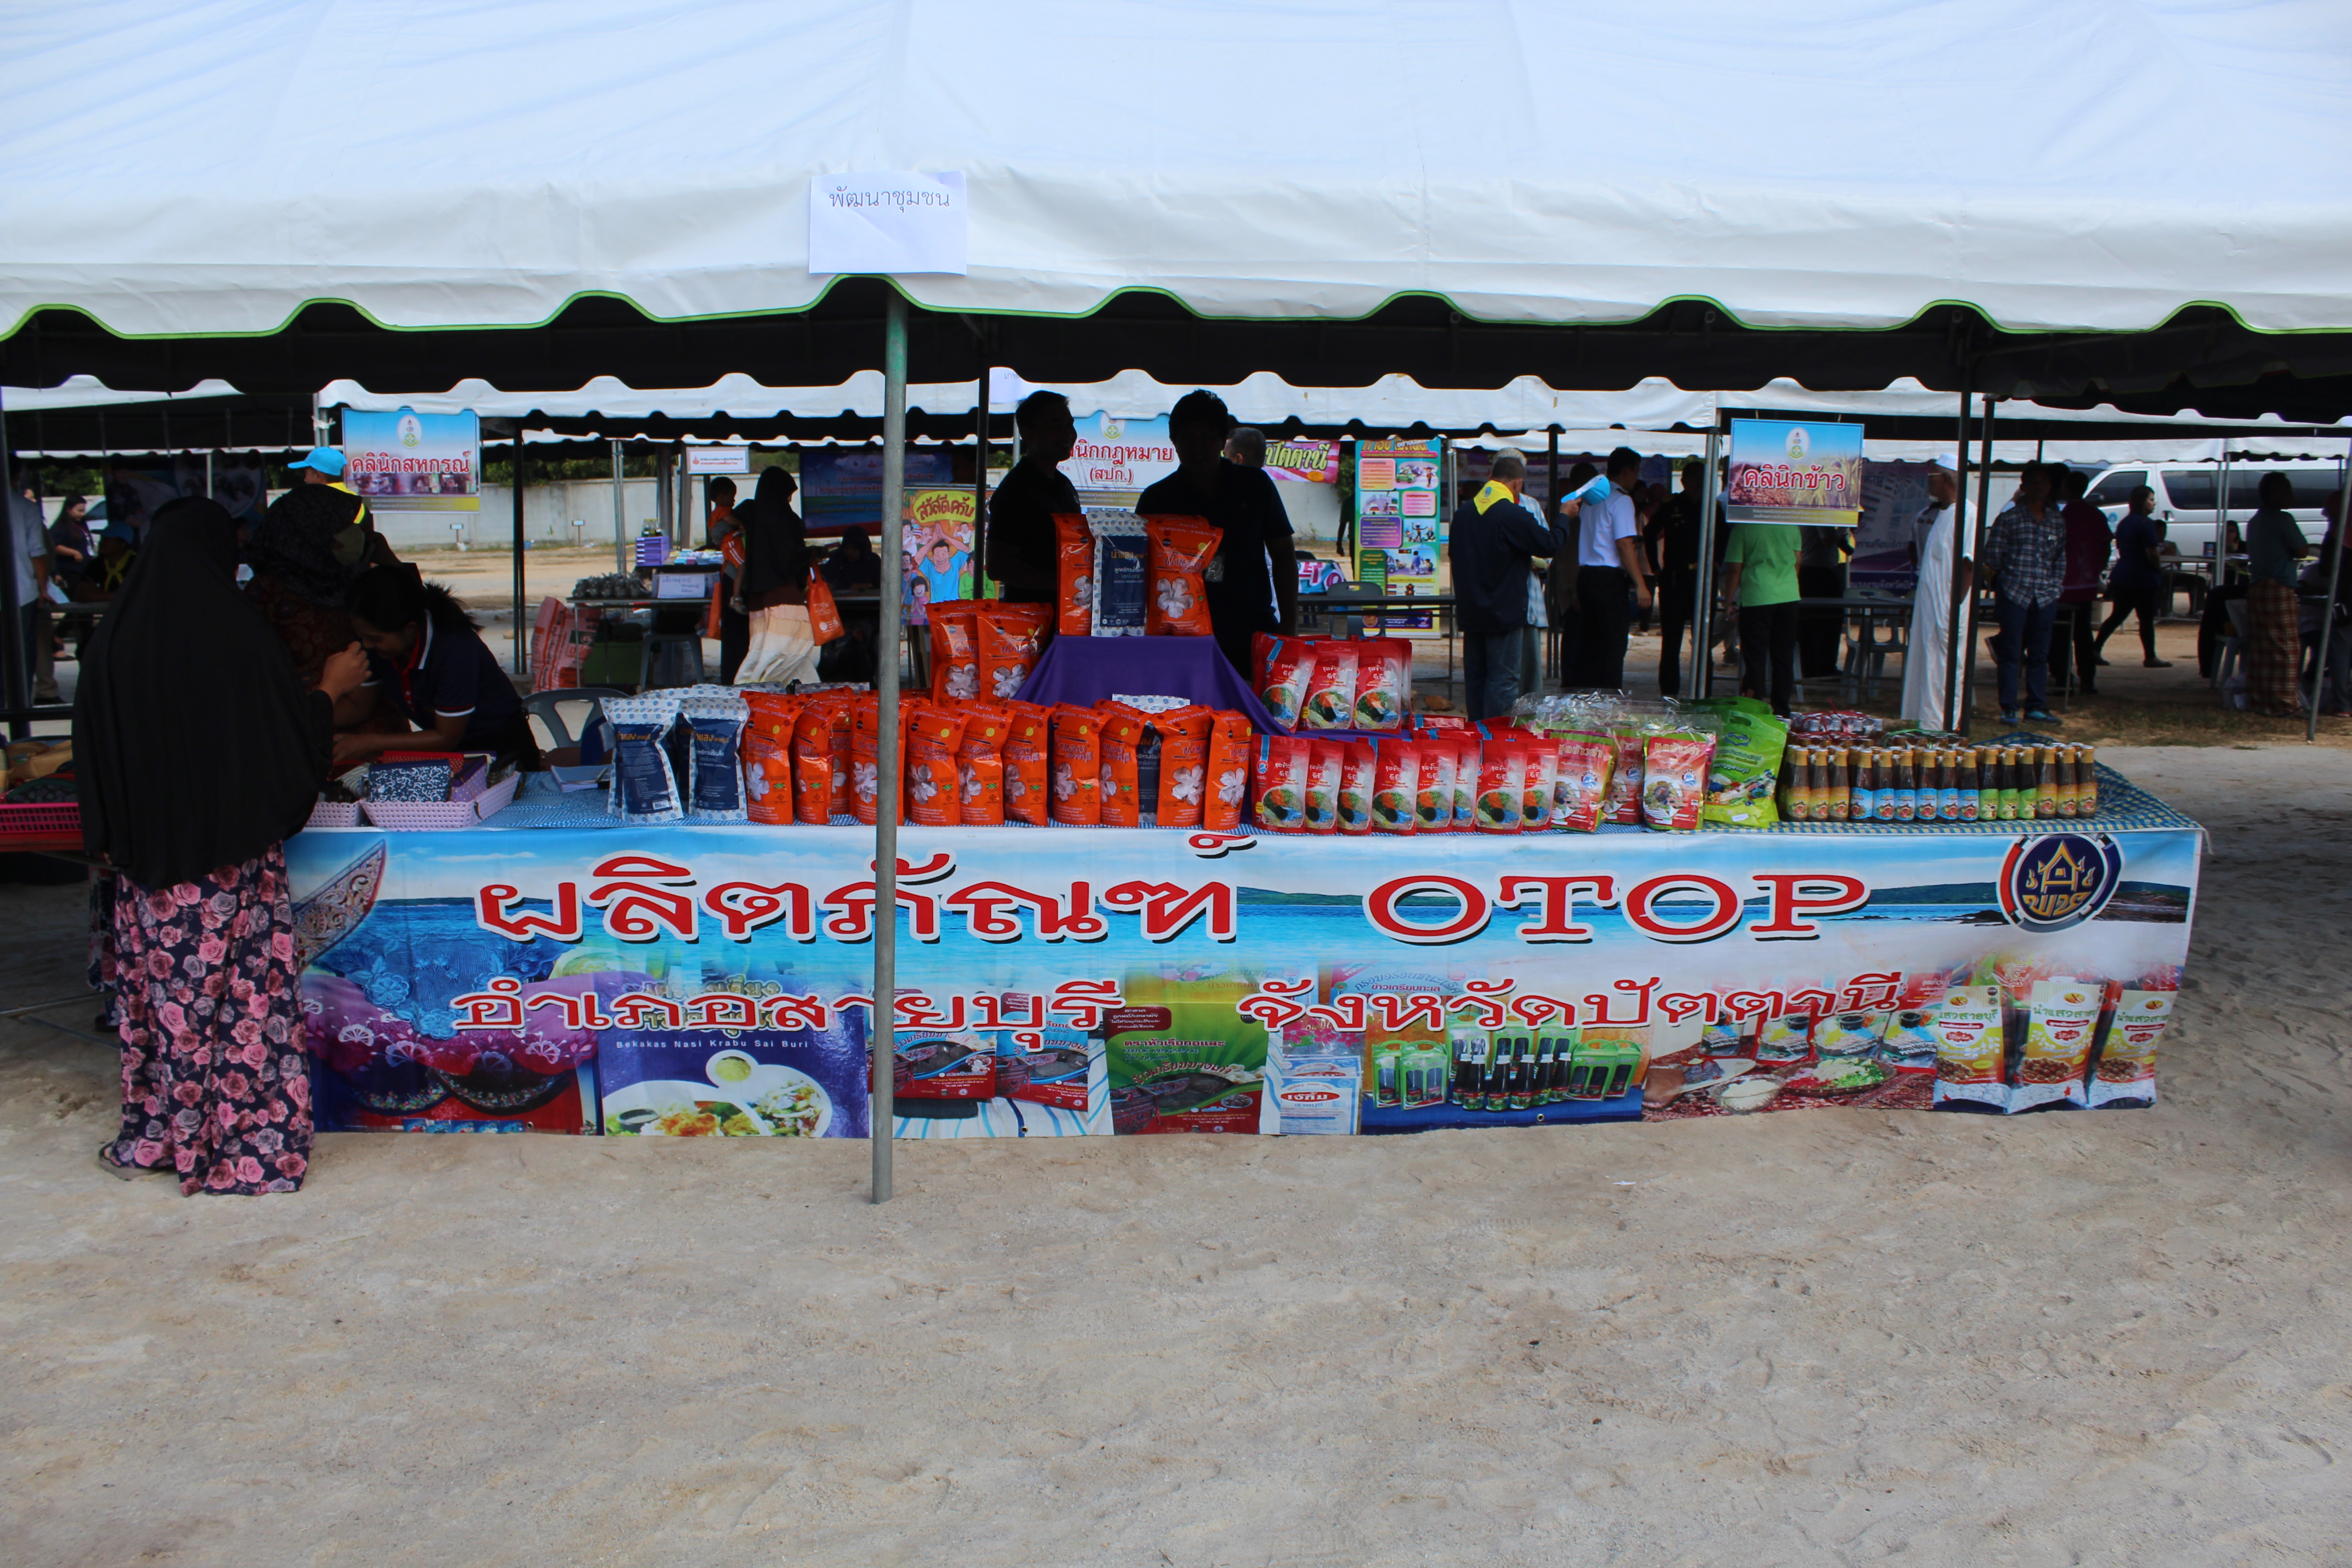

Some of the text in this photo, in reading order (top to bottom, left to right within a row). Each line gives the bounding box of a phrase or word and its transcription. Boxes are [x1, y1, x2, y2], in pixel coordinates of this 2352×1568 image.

[829, 185, 951, 213] พัฒนาชุมชน
[352, 450, 471, 474] คลินิกสหกรณ์
[1090, 467, 1133, 485] (สปก.)
[1744, 463, 1846, 491] คลินิกข้าว
[916, 494, 975, 520] สวัสดีครับ
[477, 833, 1868, 939] ผลิตภัณฑ์ OTOP
[1240, 970, 1902, 1030] จังหวัดปัตตานี
[1372, 983, 1441, 992] ข้าวเกรียบทะเล
[616, 1040, 666, 1049] Bekakas
[1123, 1038, 1226, 1048] ตราหัวเรือกอและ
[1132, 1061, 1232, 1086] ข้าวเกรียบบางเก่า
